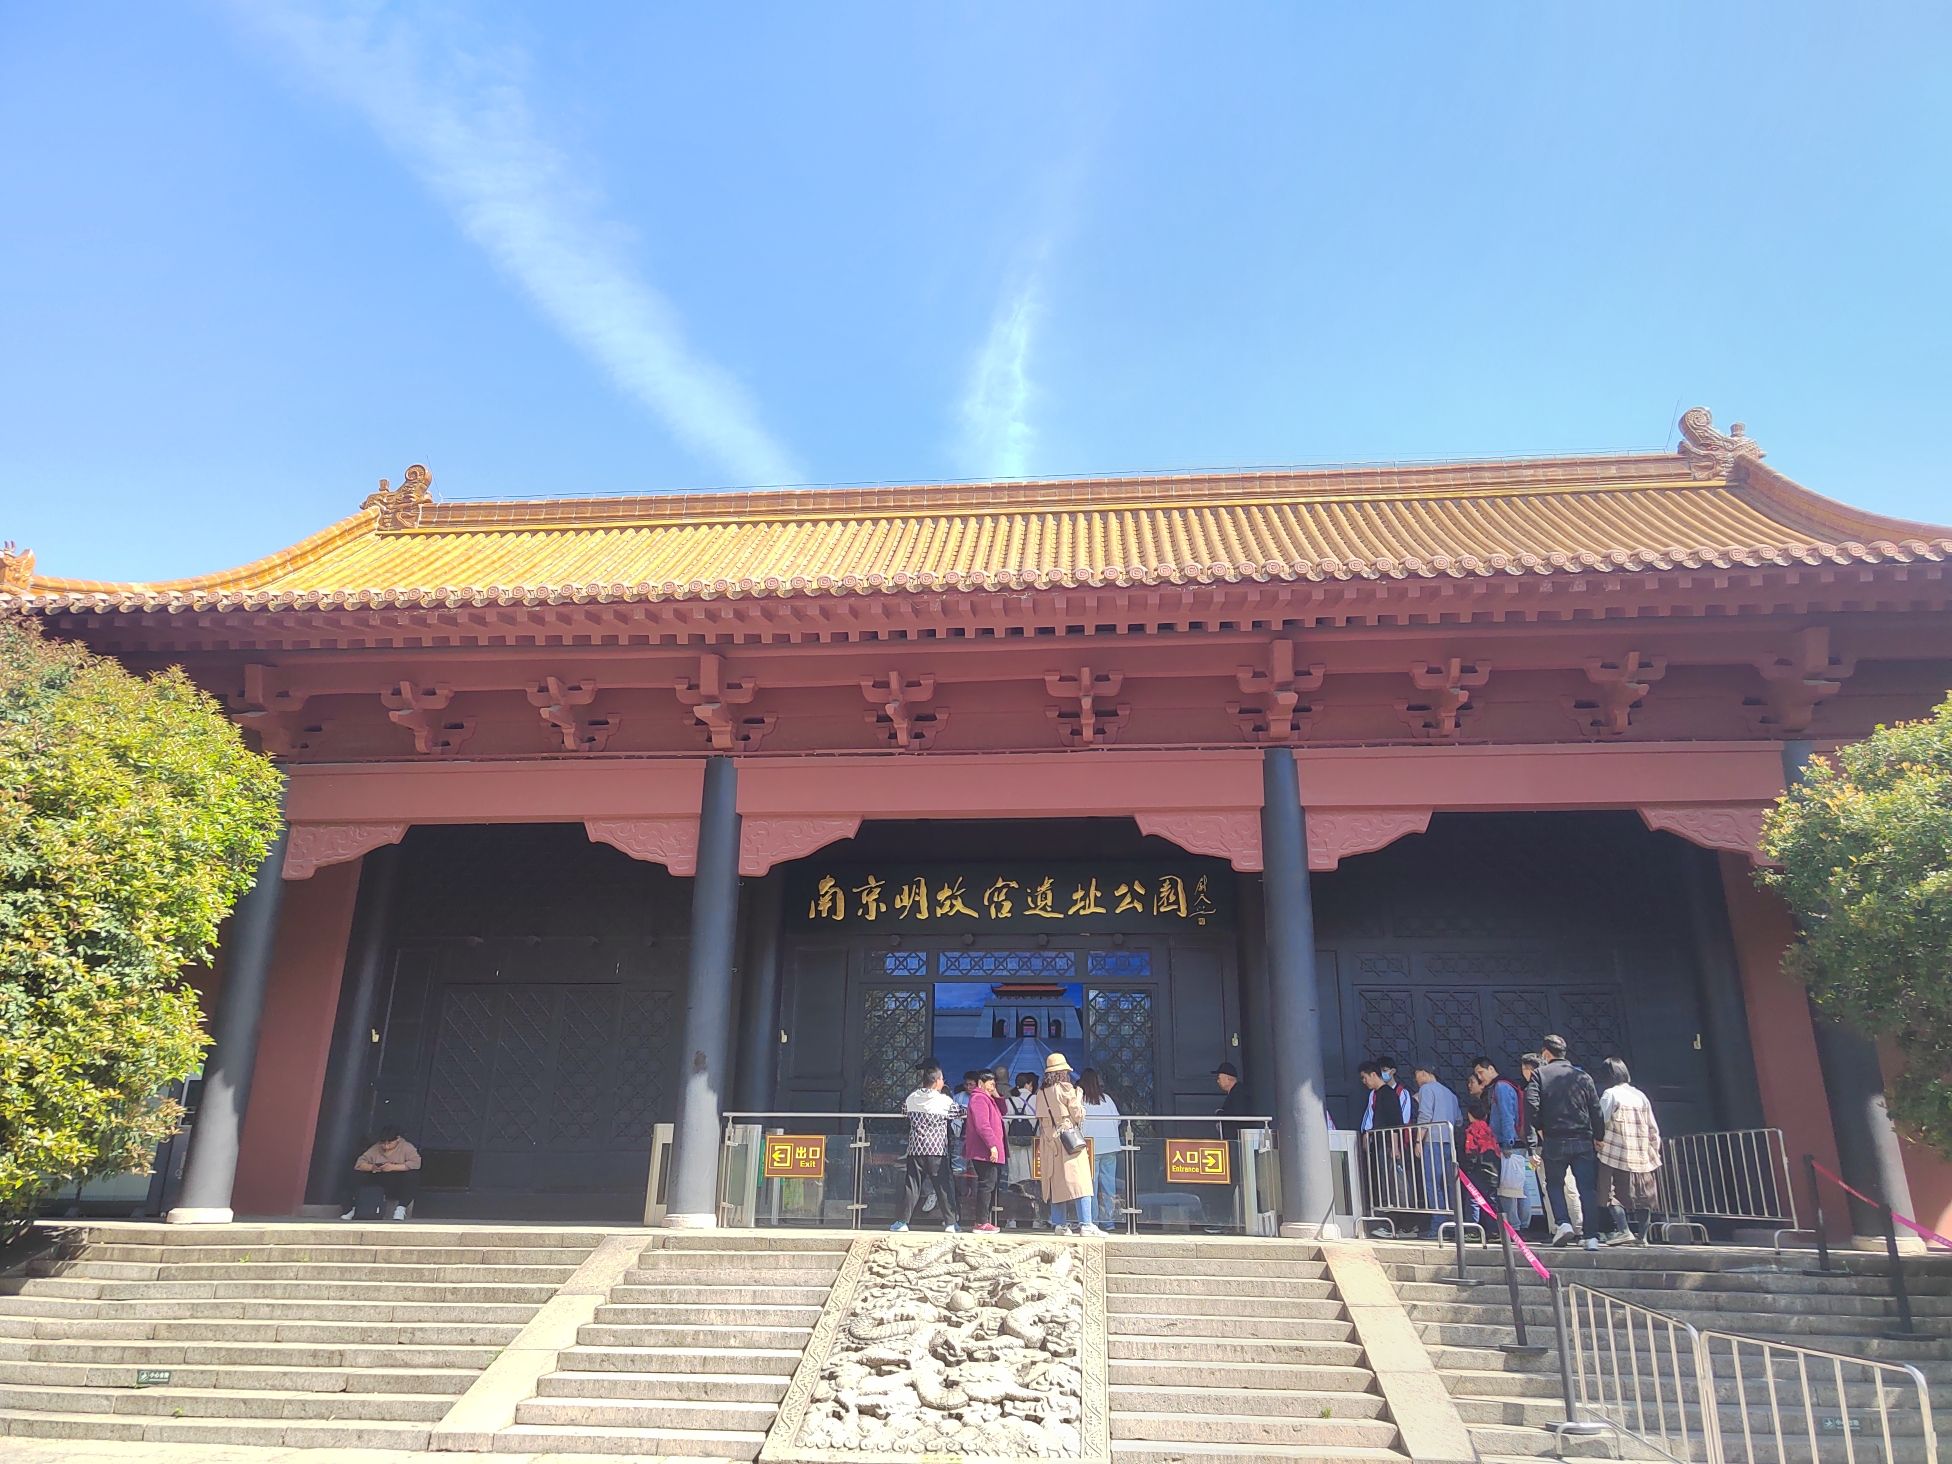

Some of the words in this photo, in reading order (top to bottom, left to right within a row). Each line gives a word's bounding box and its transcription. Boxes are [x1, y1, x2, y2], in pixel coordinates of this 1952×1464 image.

[795, 1146, 820, 1159] 出口
[1172, 1150, 1199, 1164] 入口
[1172, 1165, 1200, 1173] Entrance
